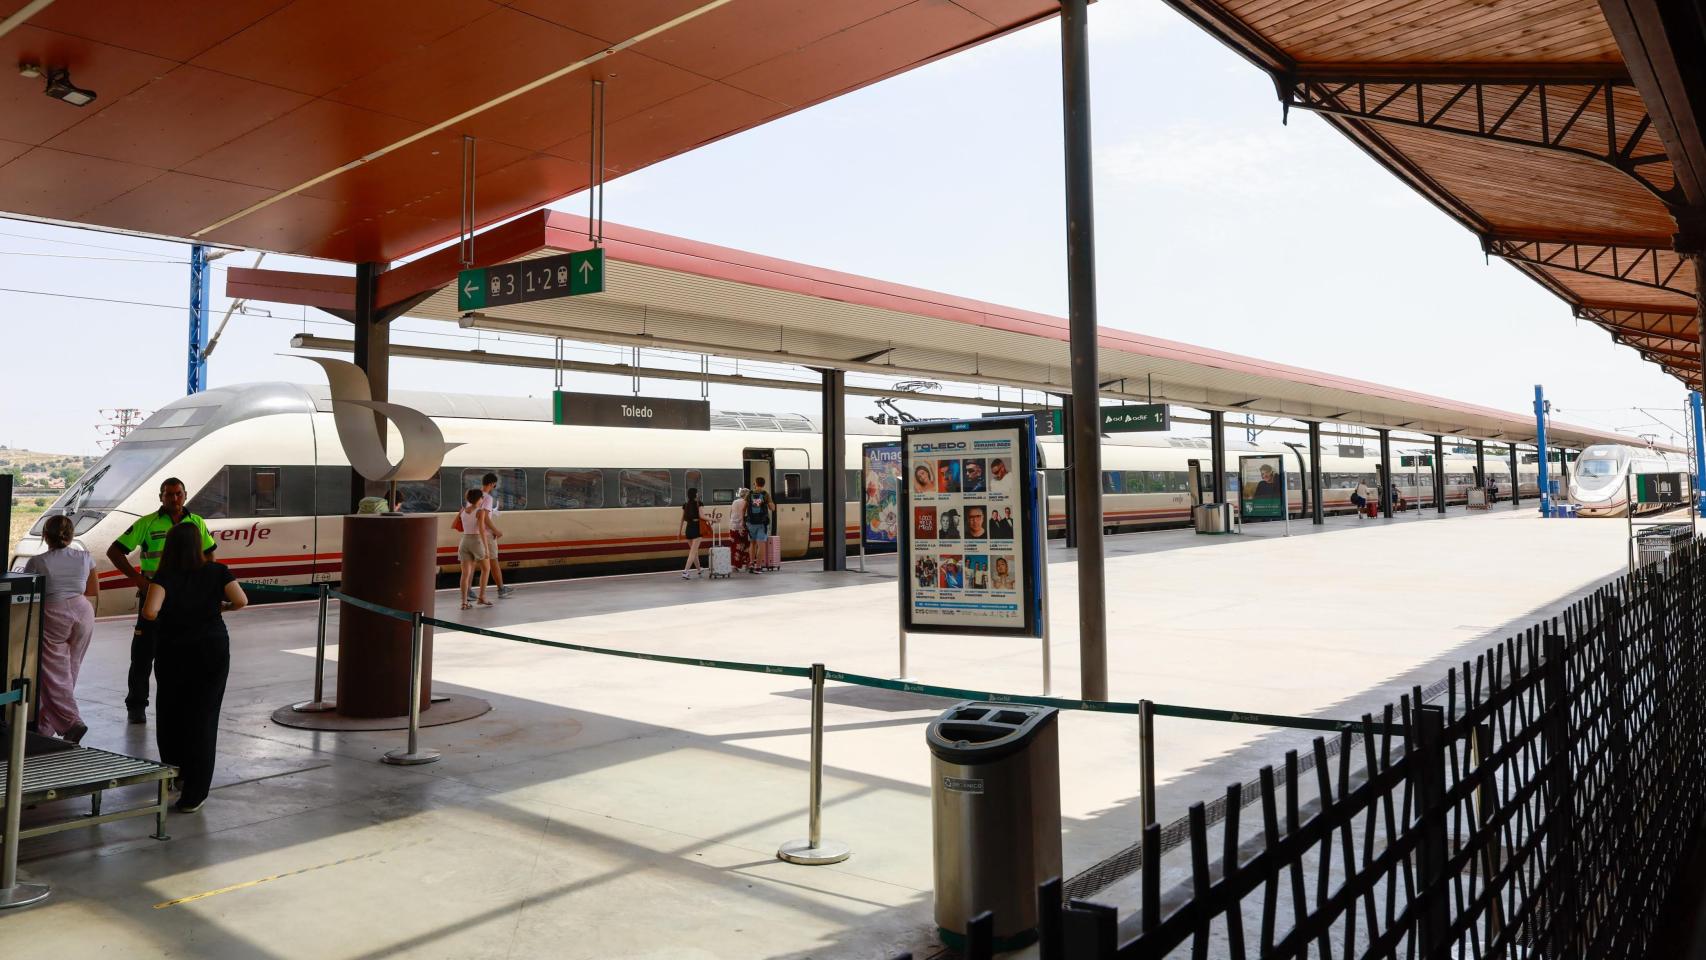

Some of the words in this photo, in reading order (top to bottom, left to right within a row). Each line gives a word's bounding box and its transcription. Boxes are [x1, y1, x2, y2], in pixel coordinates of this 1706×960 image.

[506, 274, 515, 295] 3
[621, 404, 653, 418] Toledo
[1046, 420, 1054, 433] 3
[913, 441, 967, 450] TOLEDO
[210, 521, 272, 548] renfe
